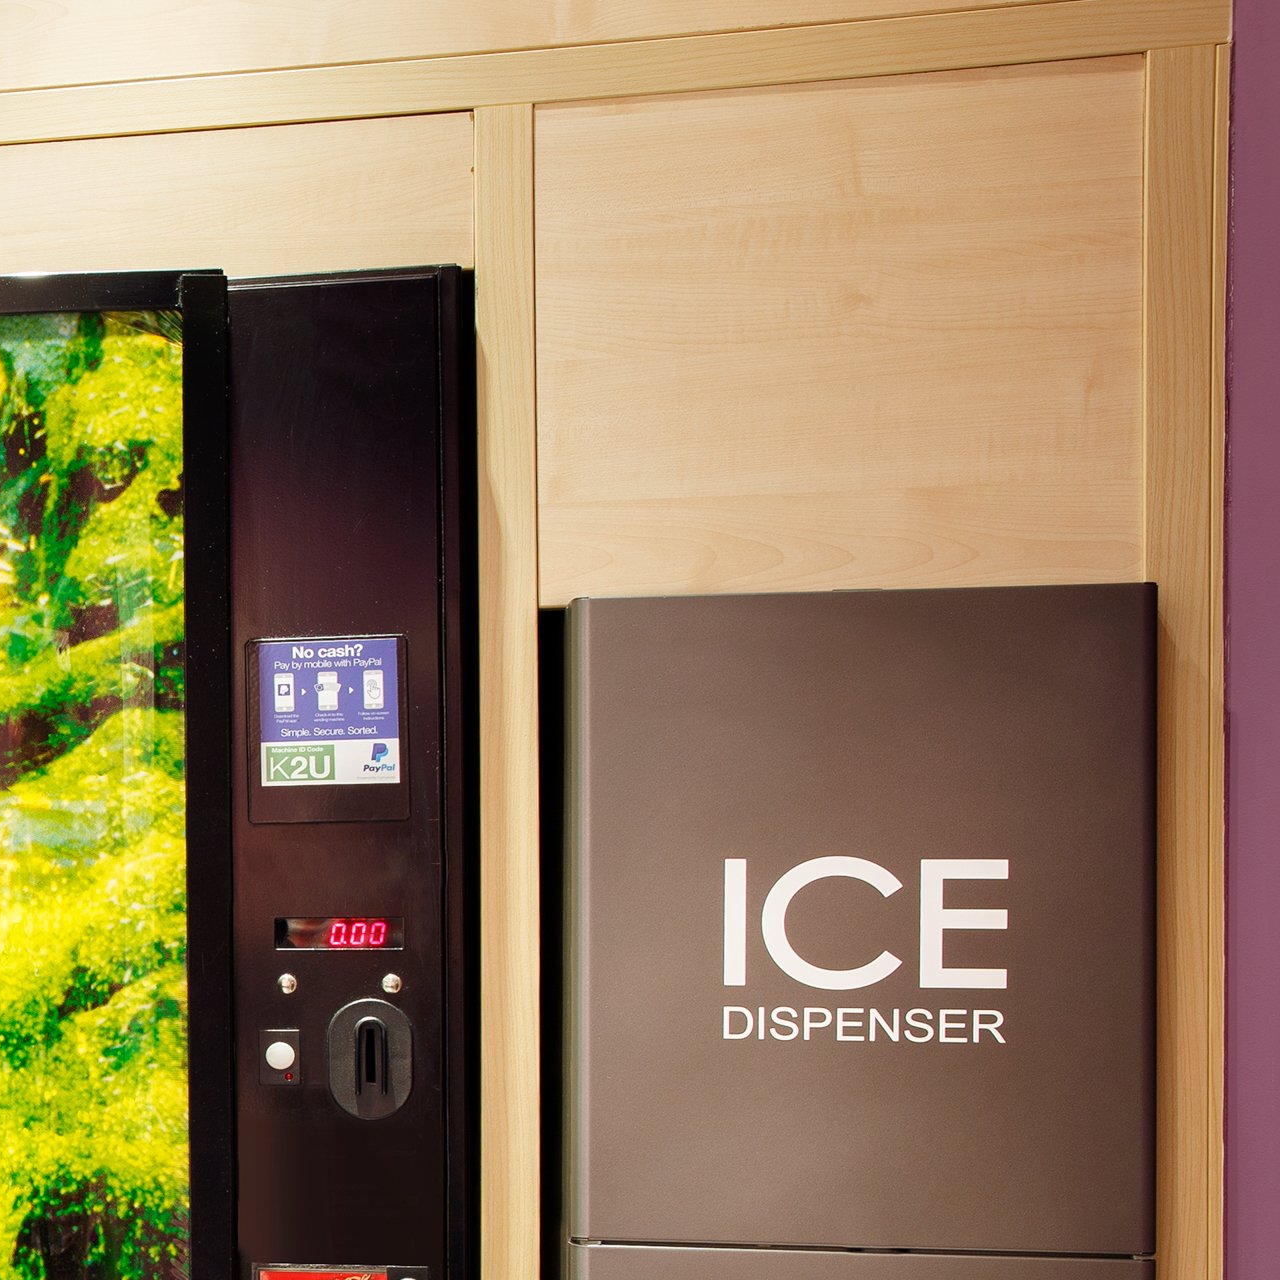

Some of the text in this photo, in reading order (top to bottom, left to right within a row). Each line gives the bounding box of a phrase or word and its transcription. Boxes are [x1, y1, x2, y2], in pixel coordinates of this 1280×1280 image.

[292, 644, 363, 659] No cash?
[274, 657, 382, 670] Pay by mobile with PayPal
[280, 726, 378, 738] Simple. Secure. Sorted.
[270, 754, 331, 780] K2U
[363, 764, 395, 772] PayPal
[723, 855, 1009, 990] ICE
[330, 922, 386, 945] 0.00
[722, 1006, 1006, 1044] DISPENSER
